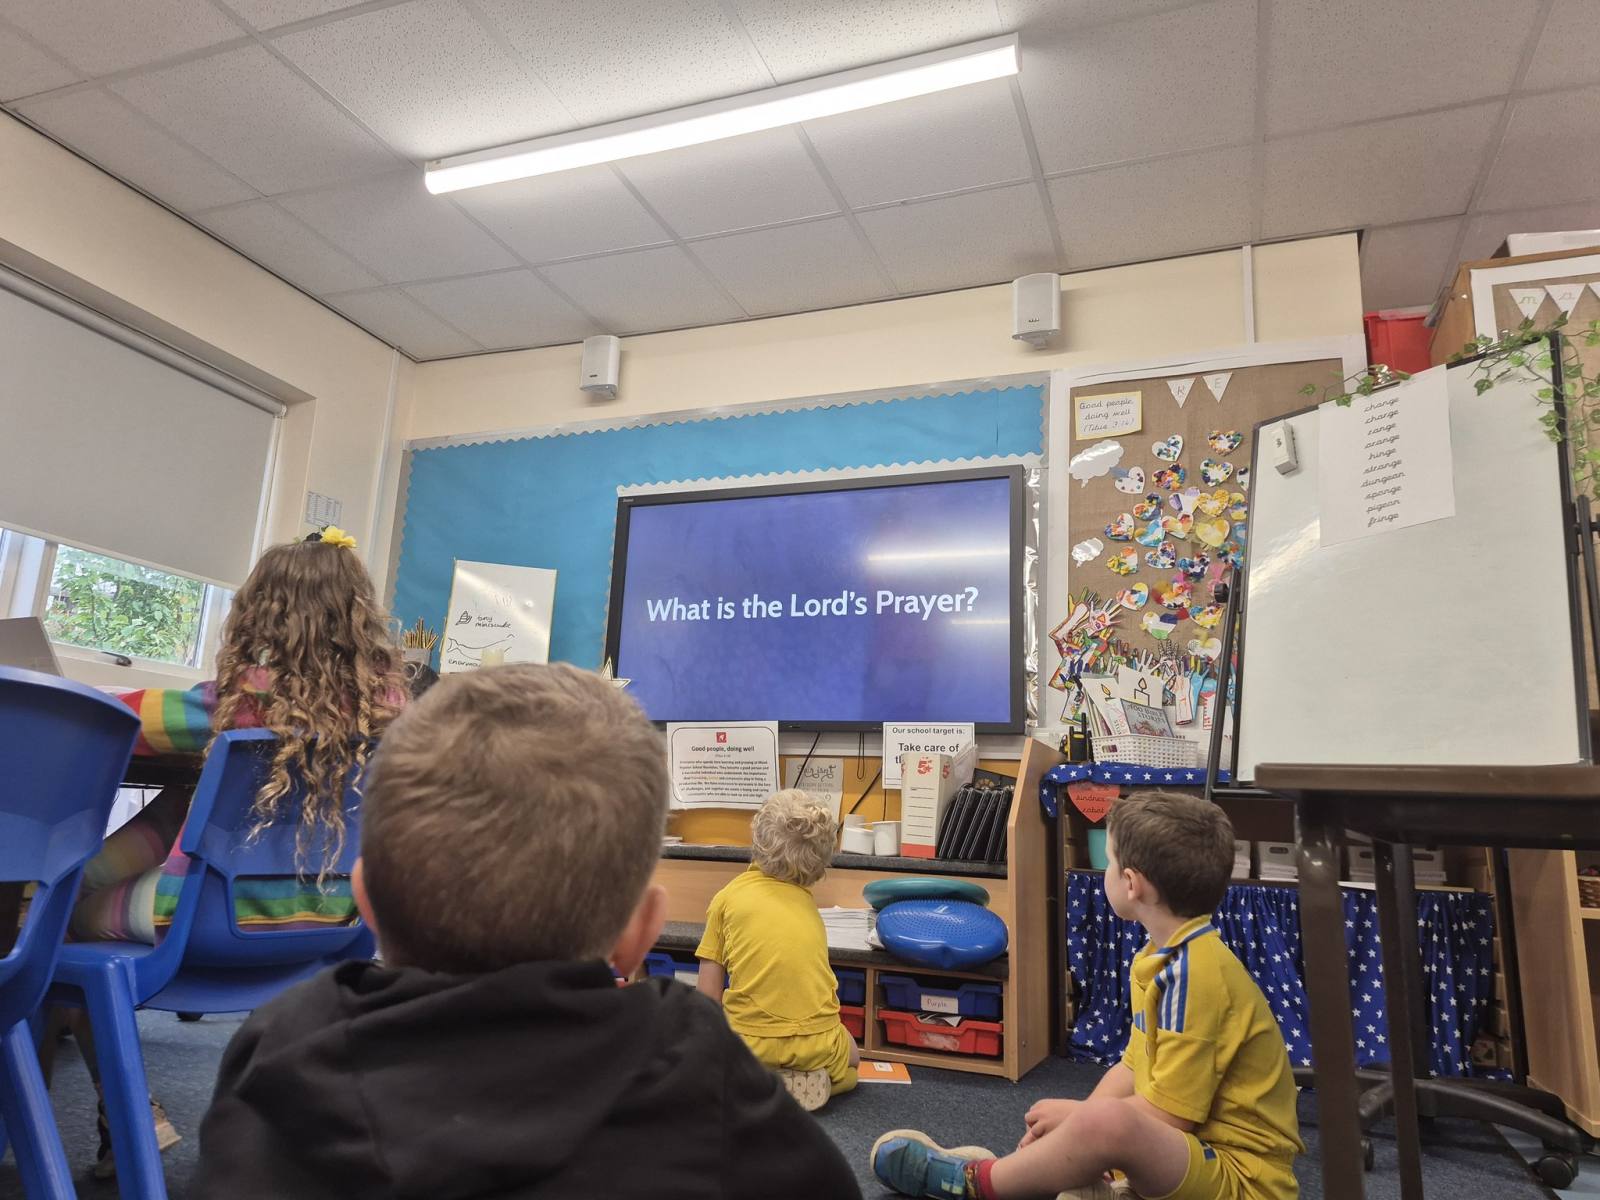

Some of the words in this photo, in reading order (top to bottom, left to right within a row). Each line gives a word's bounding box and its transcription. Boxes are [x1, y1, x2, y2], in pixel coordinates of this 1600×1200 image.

[1080, 400, 1103, 409] Good
[1364, 397, 1399, 412] change
[1084, 412, 1109, 421] doing
[1112, 409, 1130, 417] well
[1364, 410, 1399, 424] charge
[1368, 423, 1396, 435] range
[1364, 435, 1400, 449] orange
[1368, 448, 1396, 460] hinge
[1363, 460, 1402, 474] strange
[1360, 472, 1406, 488] dungeon
[1364, 486, 1402, 500] sponge
[1366, 500, 1400, 514] pigeon
[1367, 513, 1399, 528] fringe
[646, 597, 711, 622] What
[717, 597, 735, 620] is
[742, 594, 783, 619] the
[790, 590, 868, 617] Lord's
[876, 586, 979, 621] Prayer?
[933, 728, 955, 736] target
[898, 743, 921, 752] Take
[949, 744, 960, 752] of
